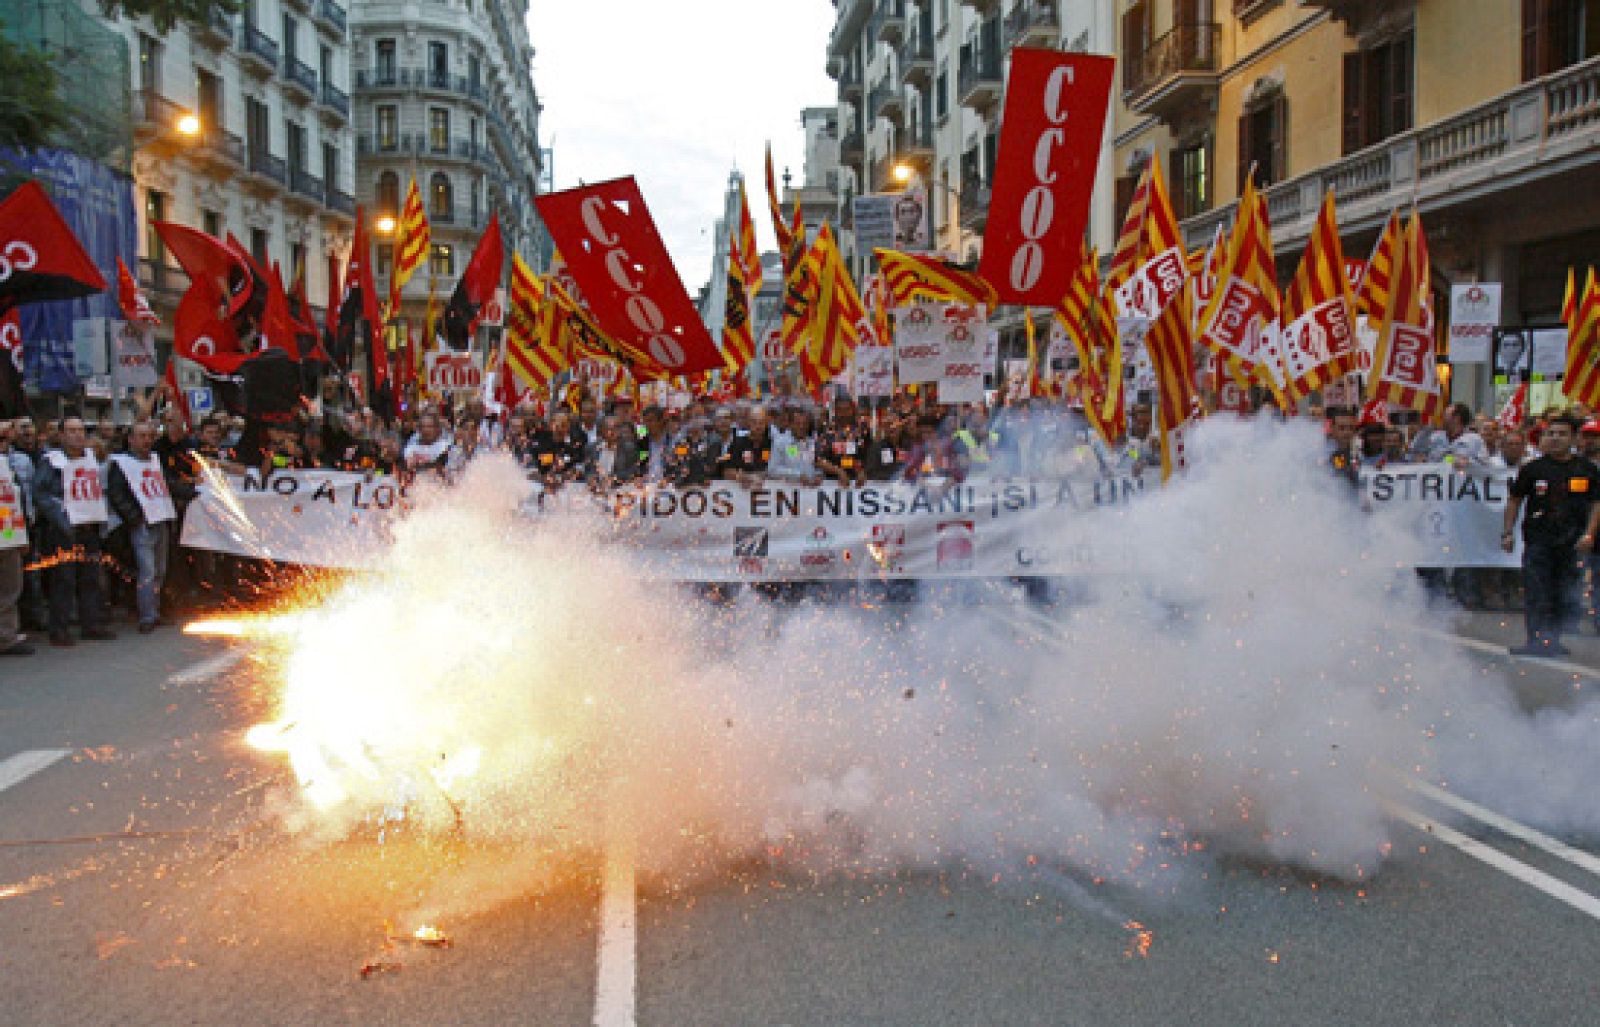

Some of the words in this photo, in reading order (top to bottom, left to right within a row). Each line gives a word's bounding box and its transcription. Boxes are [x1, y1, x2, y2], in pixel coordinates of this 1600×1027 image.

[1009, 64, 1074, 292] CCOO
[581, 195, 686, 368] CCOO
[243, 474, 298, 494] NO
[312, 480, 336, 503] A
[353, 482, 407, 509] LO
[750, 489, 799, 517] EN
[1372, 473, 1503, 501] STRIAL
